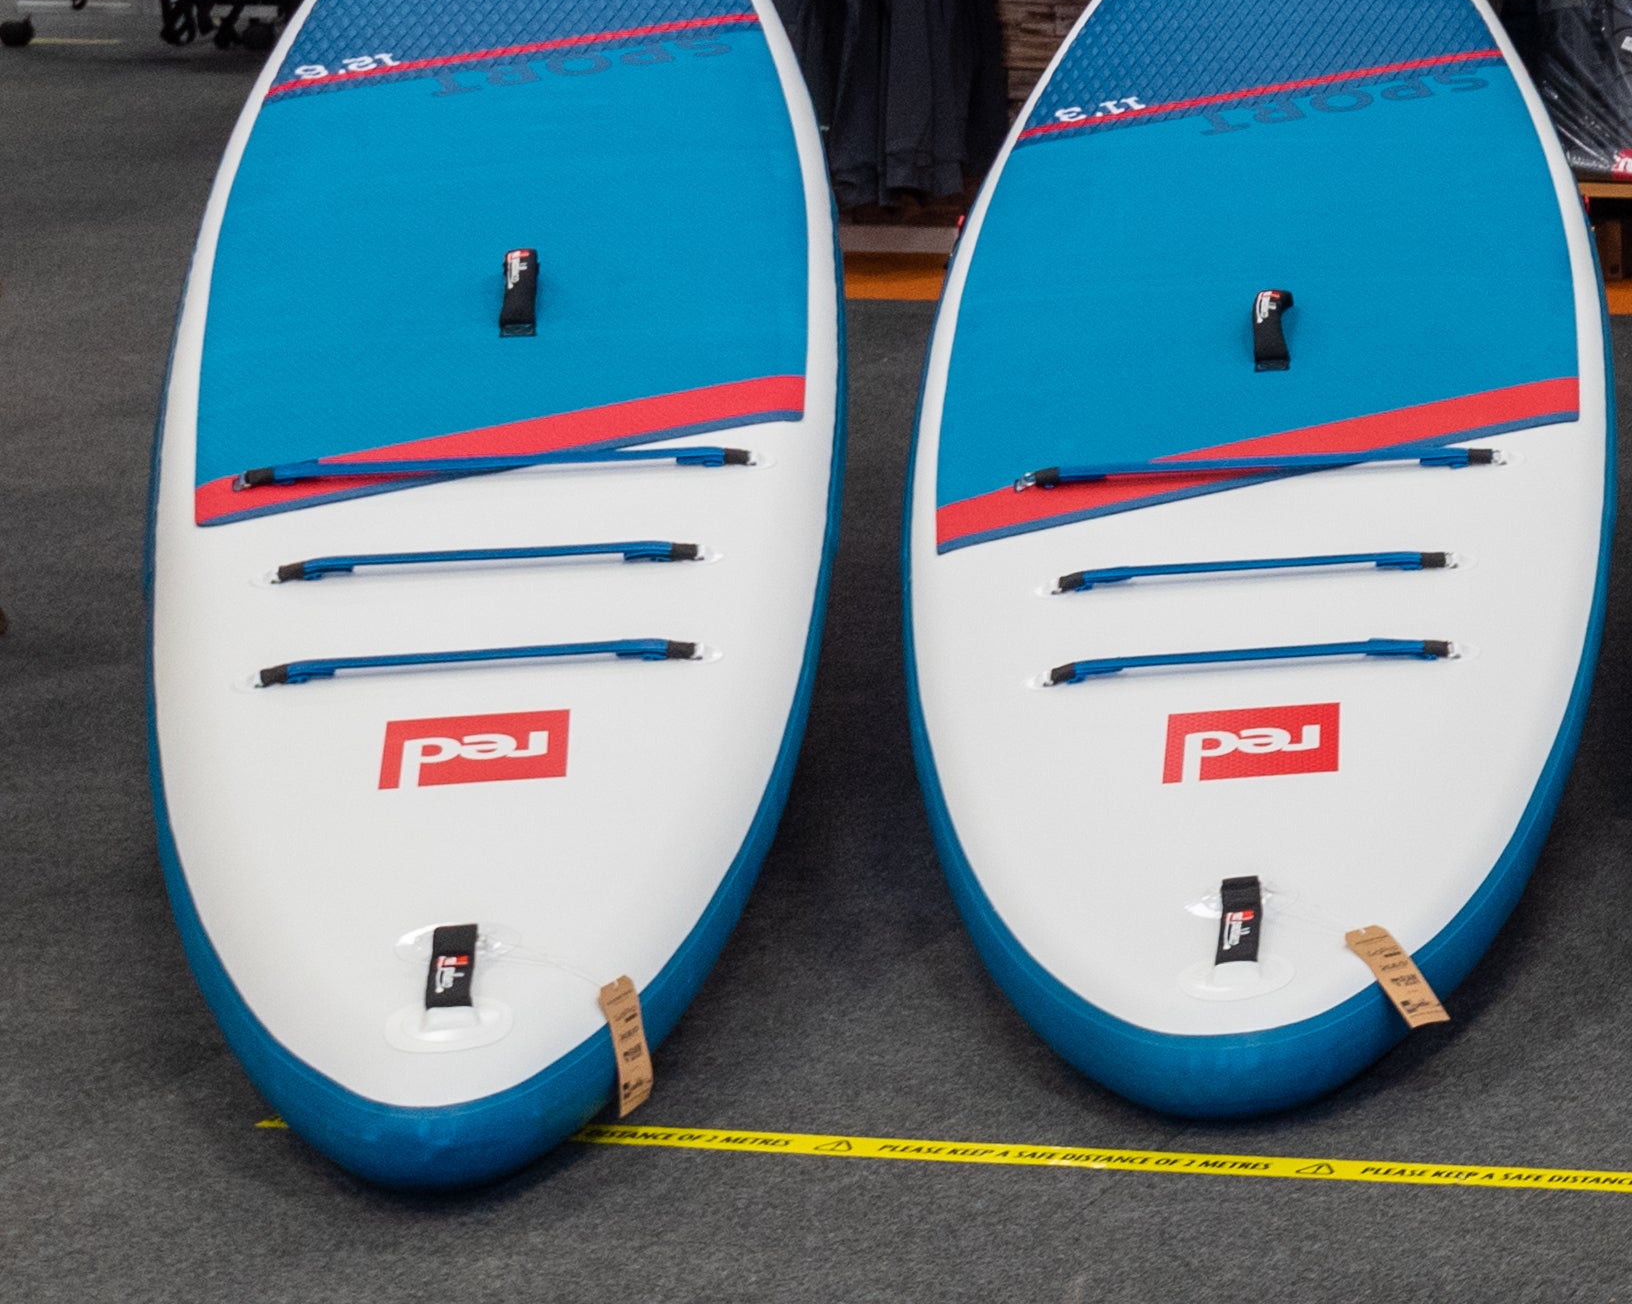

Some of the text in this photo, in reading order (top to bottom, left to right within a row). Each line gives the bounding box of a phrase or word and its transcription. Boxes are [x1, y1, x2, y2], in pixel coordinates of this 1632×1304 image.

[431, 36, 732, 98] SPORT
[1054, 95, 1147, 124] 11'3
[1200, 70, 1490, 136] SPORT
[398, 729, 550, 789] red
[1180, 723, 1321, 783] red
[588, 1130, 793, 1148] DISTANCE OF 2 METRES
[879, 1141, 1273, 1172] PLEASE KEEP A SAFE DISTANCE OF 2 METRES
[1360, 1166, 1427, 1179] PLEASE
[1430, 1169, 1480, 1181] KEEP
[1484, 1171, 1496, 1181] A
[1501, 1172, 1543, 1183] SAFE
